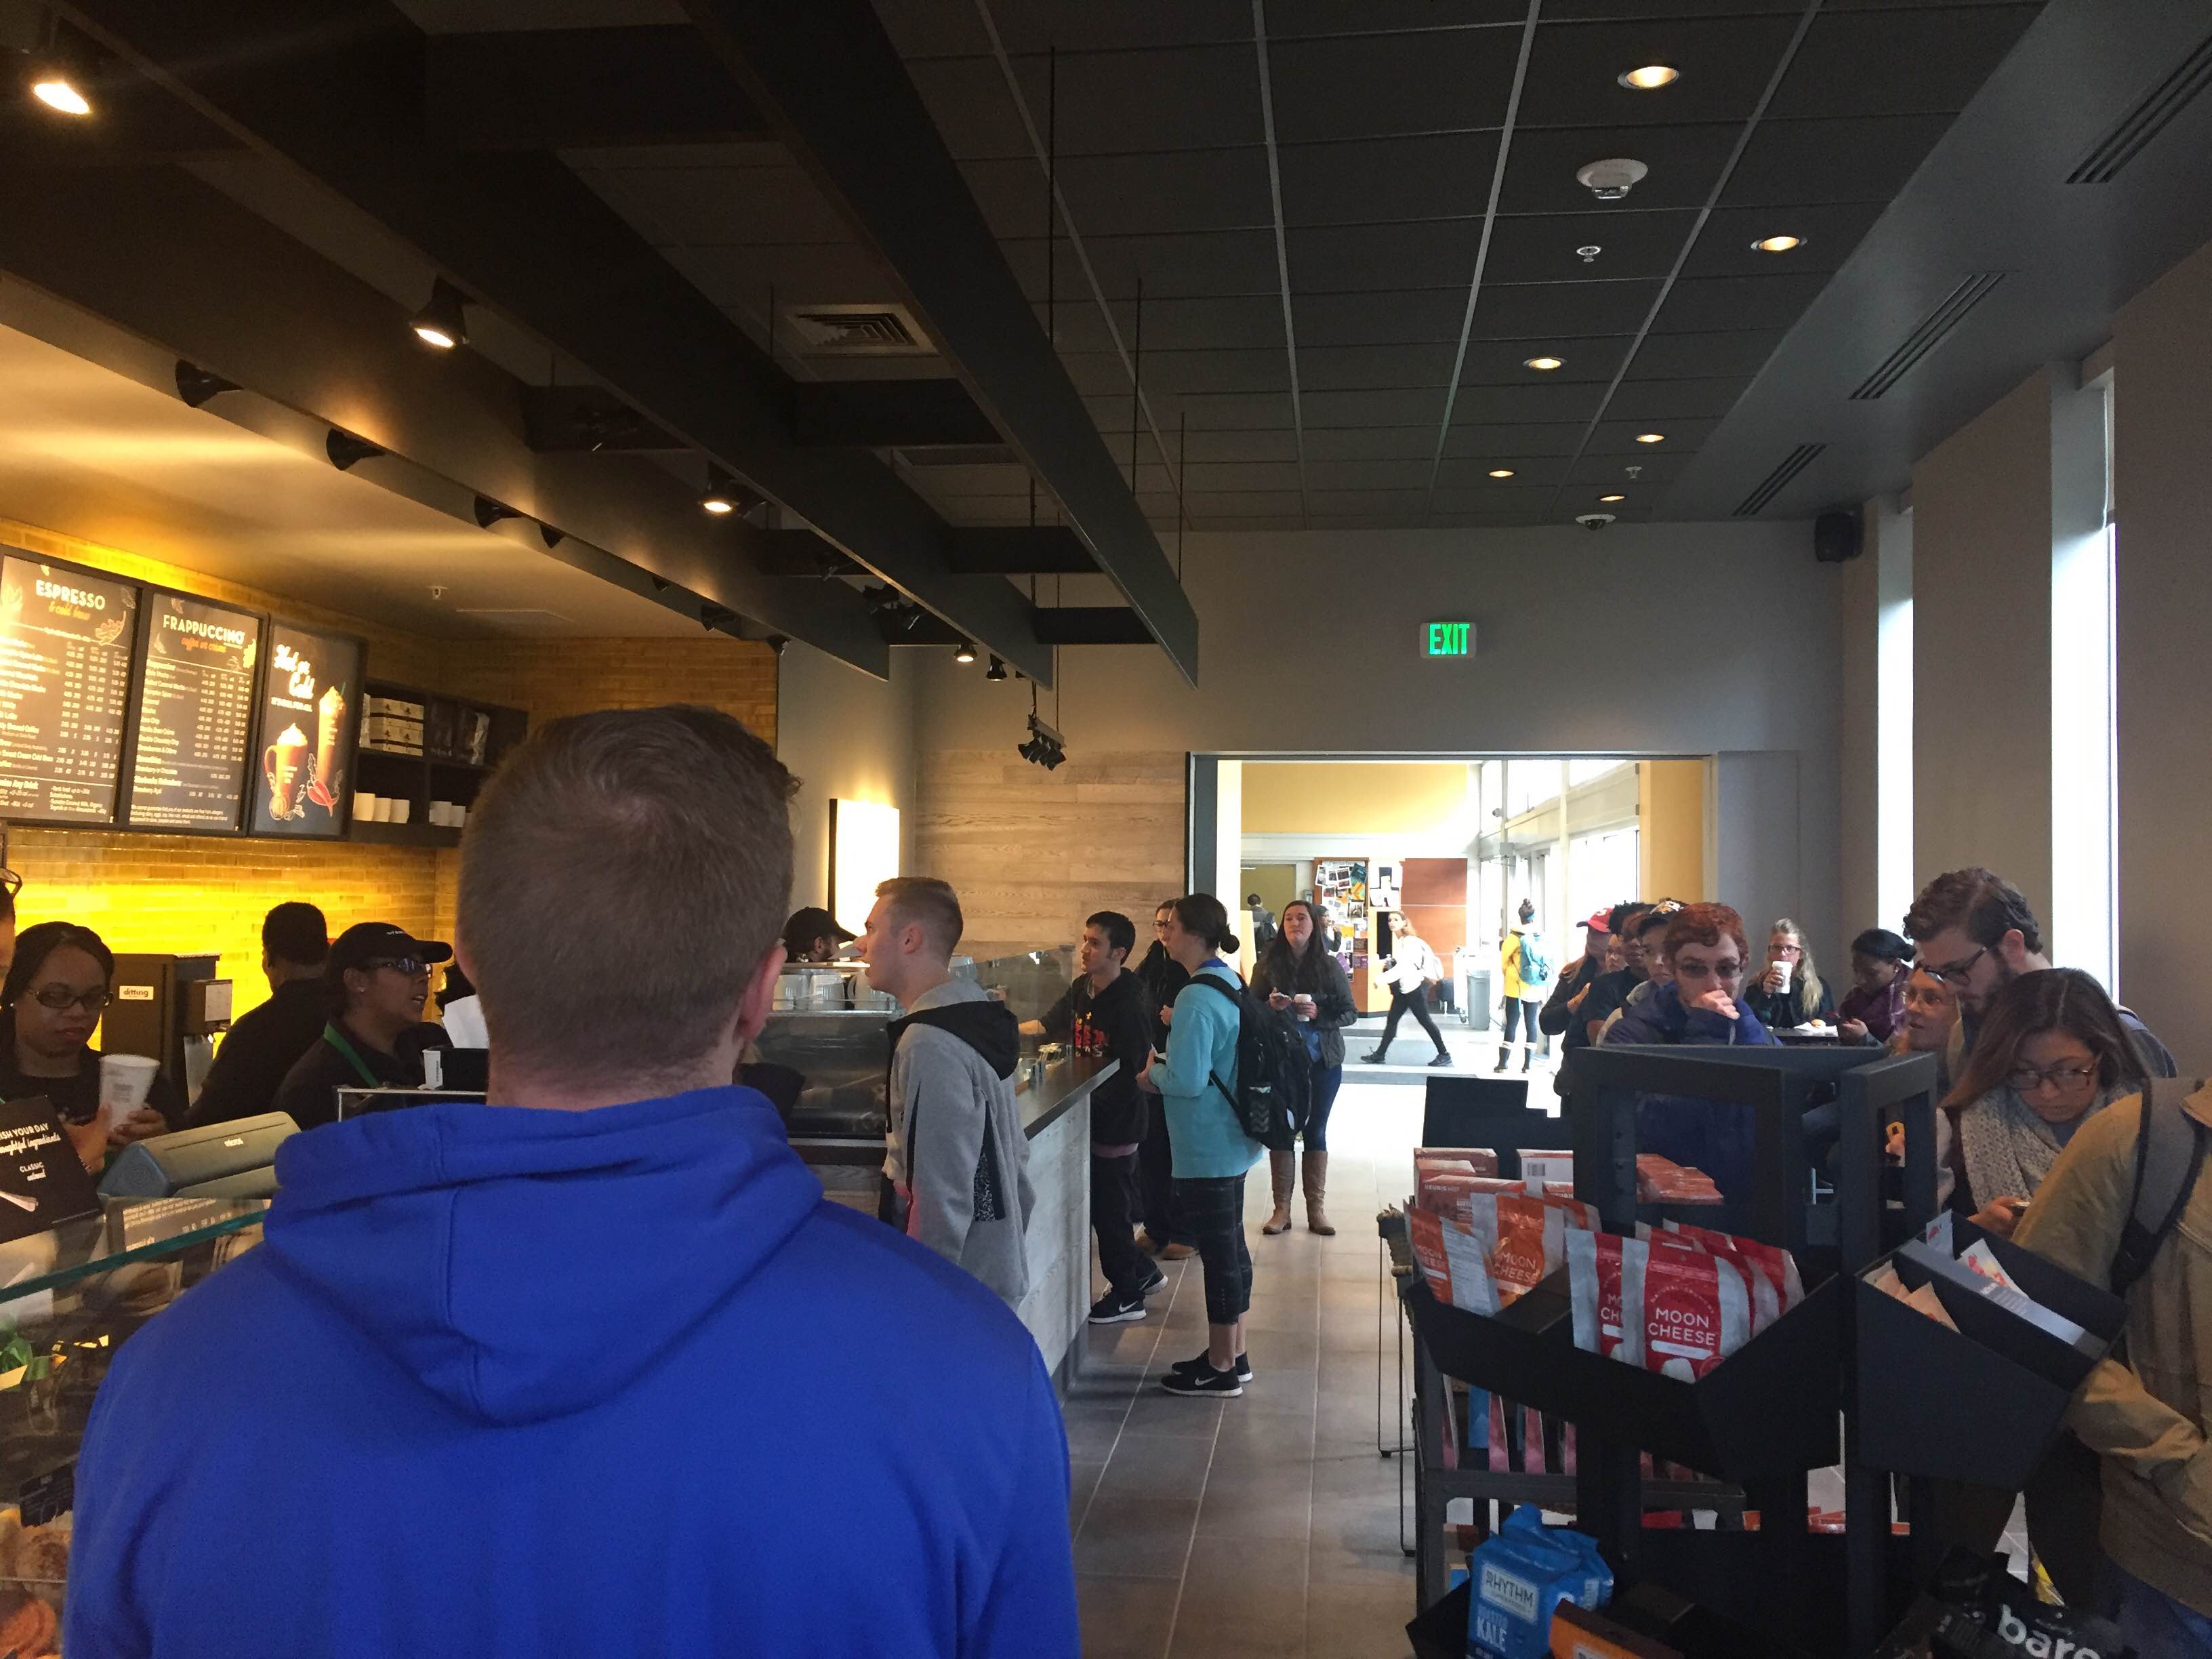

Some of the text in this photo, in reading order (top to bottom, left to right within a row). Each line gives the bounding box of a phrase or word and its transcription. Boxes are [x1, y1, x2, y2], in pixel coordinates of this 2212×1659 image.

[36, 579, 106, 610] ESPRESSO
[1429, 623, 1470, 655] EXIT
[124, 989, 148, 997] ditting
[0, 1122, 49, 1141] ISH YOUR DAY
[20, 1162, 44, 1172] CLASSIC
[1500, 1252, 1536, 1270] MOON
[1655, 1307, 1709, 1328] MOON
[1648, 1322, 1716, 1346] CHEESE
[1486, 1570, 1534, 1608] RHYTHM
[1475, 1616, 1507, 1652] KALE
